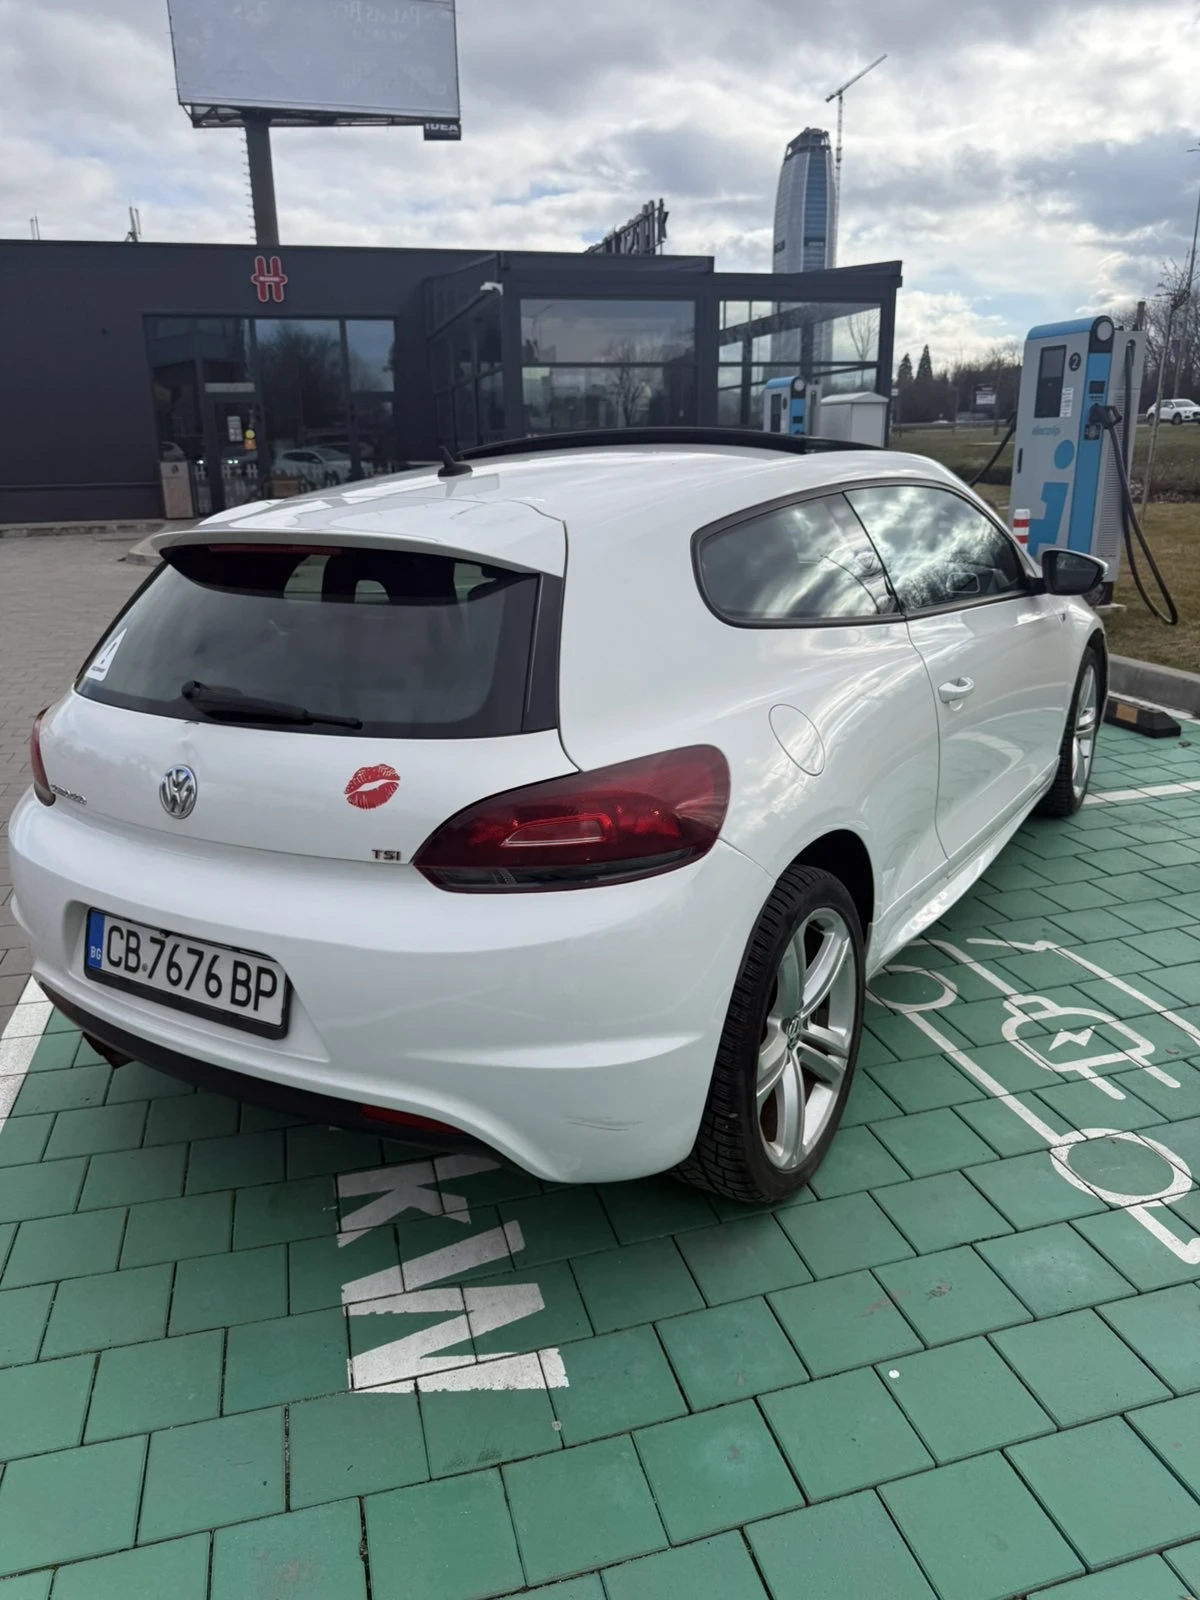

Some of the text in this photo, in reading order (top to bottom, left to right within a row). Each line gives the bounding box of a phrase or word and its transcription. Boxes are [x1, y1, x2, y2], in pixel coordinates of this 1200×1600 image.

[371, 849, 401, 861] TSI
[90, 946, 102, 960] BG
[147, 936, 222, 999] 7676
[230, 960, 277, 1012] BP
